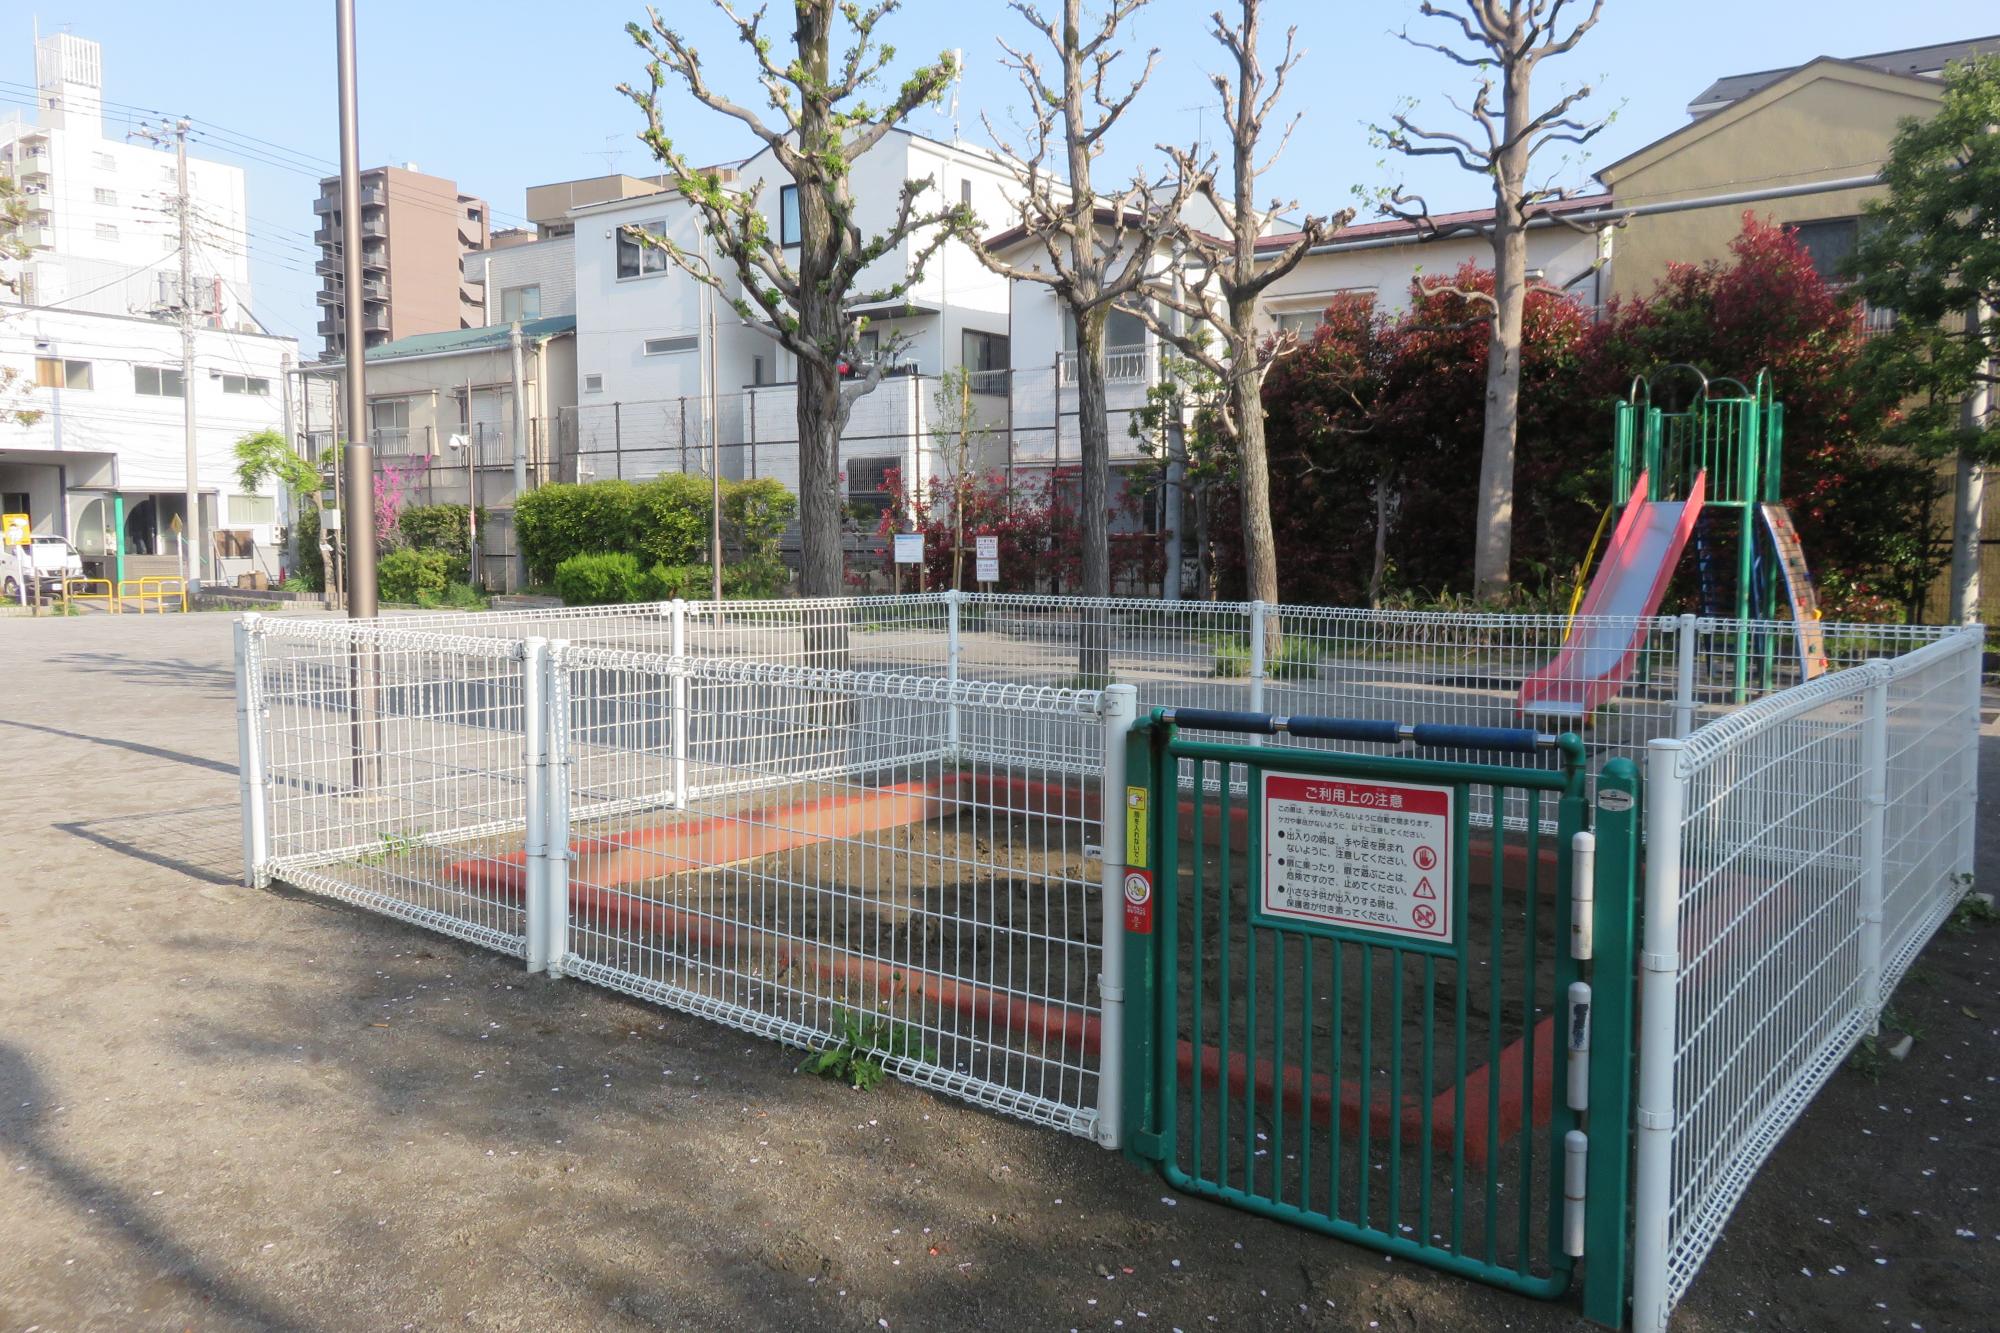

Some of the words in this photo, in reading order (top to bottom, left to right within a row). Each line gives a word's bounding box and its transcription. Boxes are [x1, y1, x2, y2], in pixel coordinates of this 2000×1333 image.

[1305, 786, 1403, 808] ご利用上の注意
